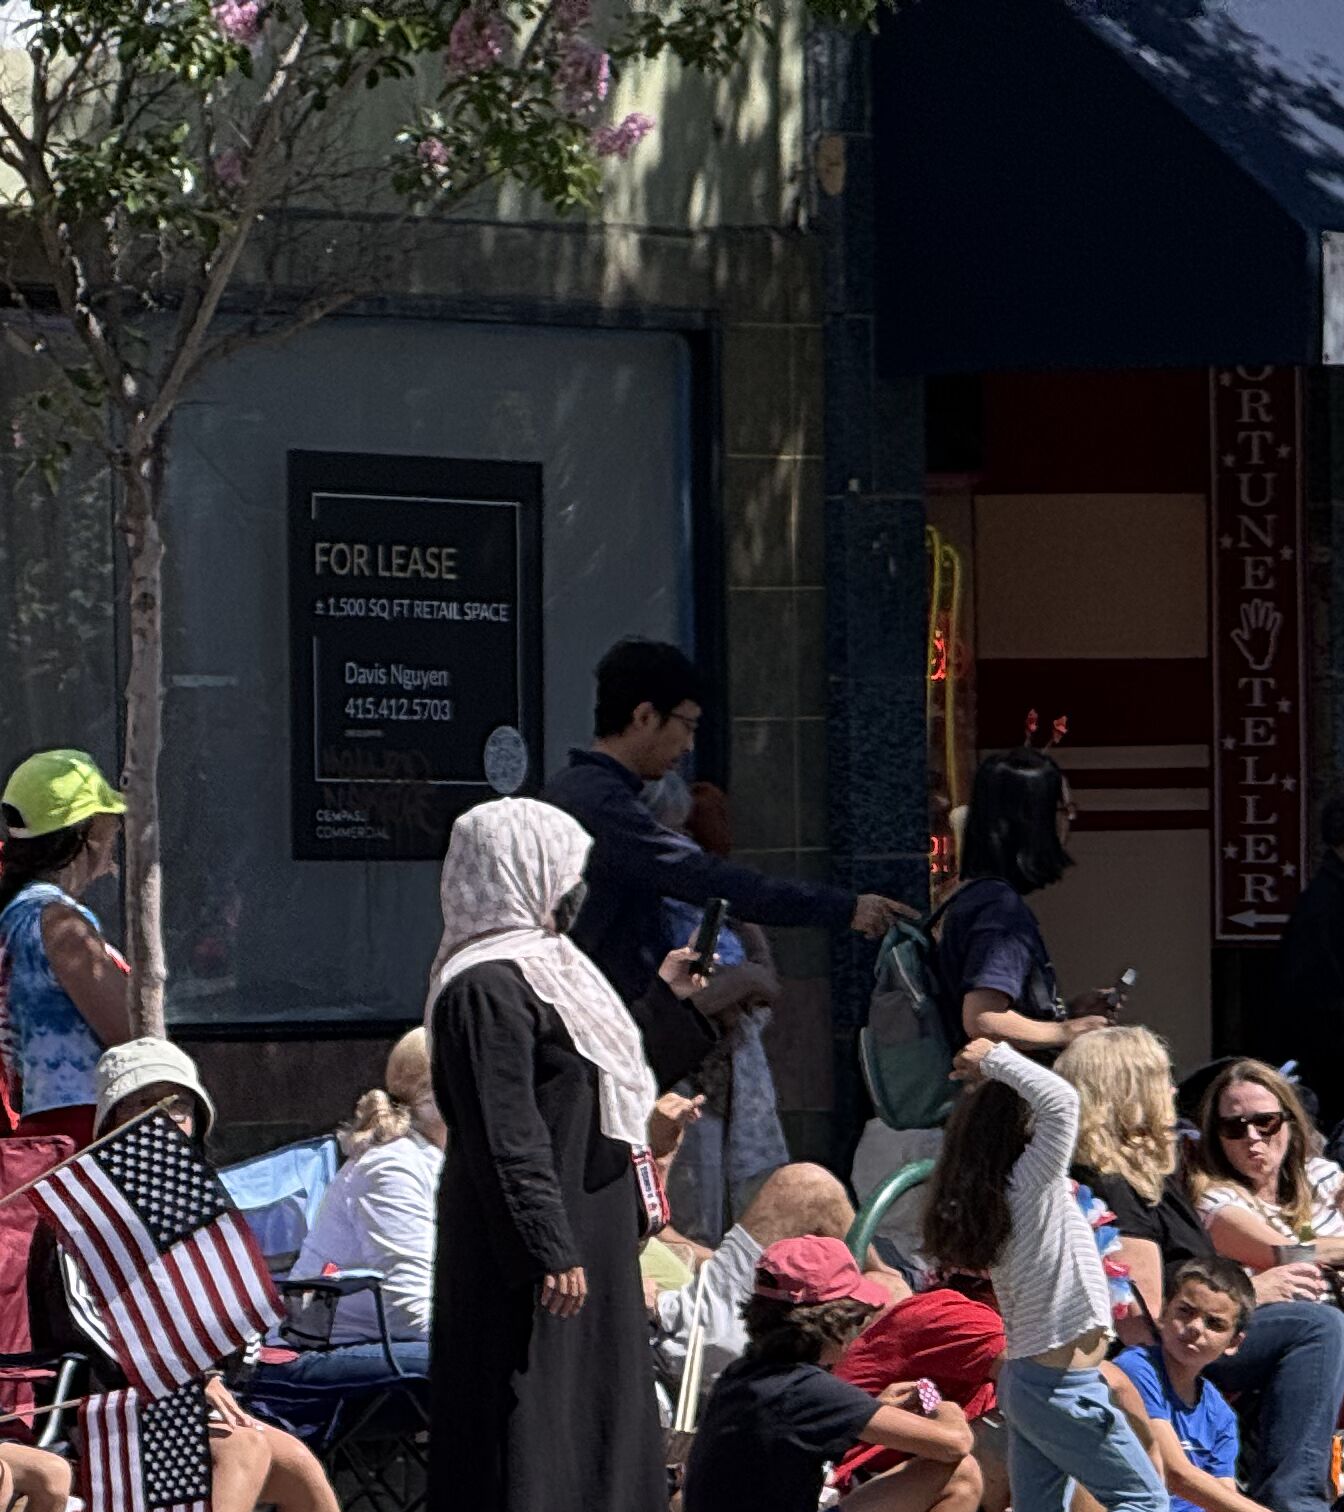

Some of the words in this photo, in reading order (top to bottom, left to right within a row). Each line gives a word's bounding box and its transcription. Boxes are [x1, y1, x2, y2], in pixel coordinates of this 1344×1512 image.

[1236, 366, 1278, 590] RTUNE
[315, 542, 369, 576] FOR
[378, 545, 459, 580] LEASE
[328, 598, 366, 616] 1,500
[368, 598, 390, 620] SQ
[393, 600, 410, 618] FT
[414, 600, 461, 620] RETAIL
[463, 602, 510, 622] SPACE
[345, 662, 386, 685] Davis
[391, 664, 449, 690] Nguyen
[345, 696, 451, 720] 415.412.5703
[1238, 677, 1278, 903] TELLER
